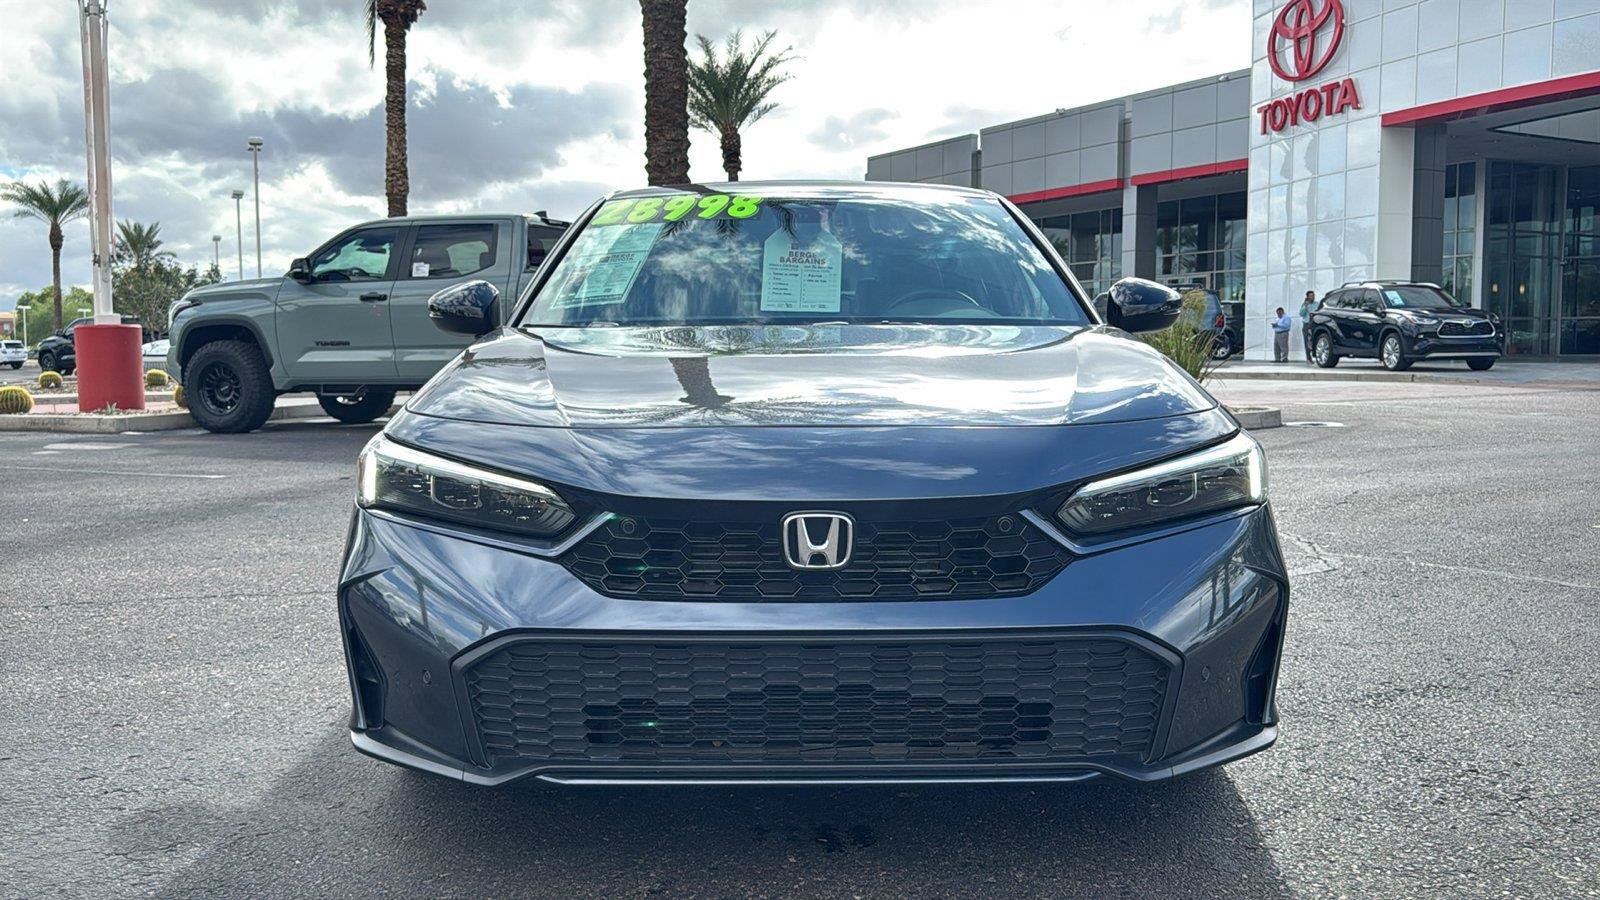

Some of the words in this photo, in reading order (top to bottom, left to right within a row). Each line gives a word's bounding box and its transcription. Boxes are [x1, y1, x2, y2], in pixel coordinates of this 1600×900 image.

[1257, 78, 1361, 135] TOYOTA
[591, 194, 764, 225] 28998
[779, 256, 827, 265] BARGAINS
